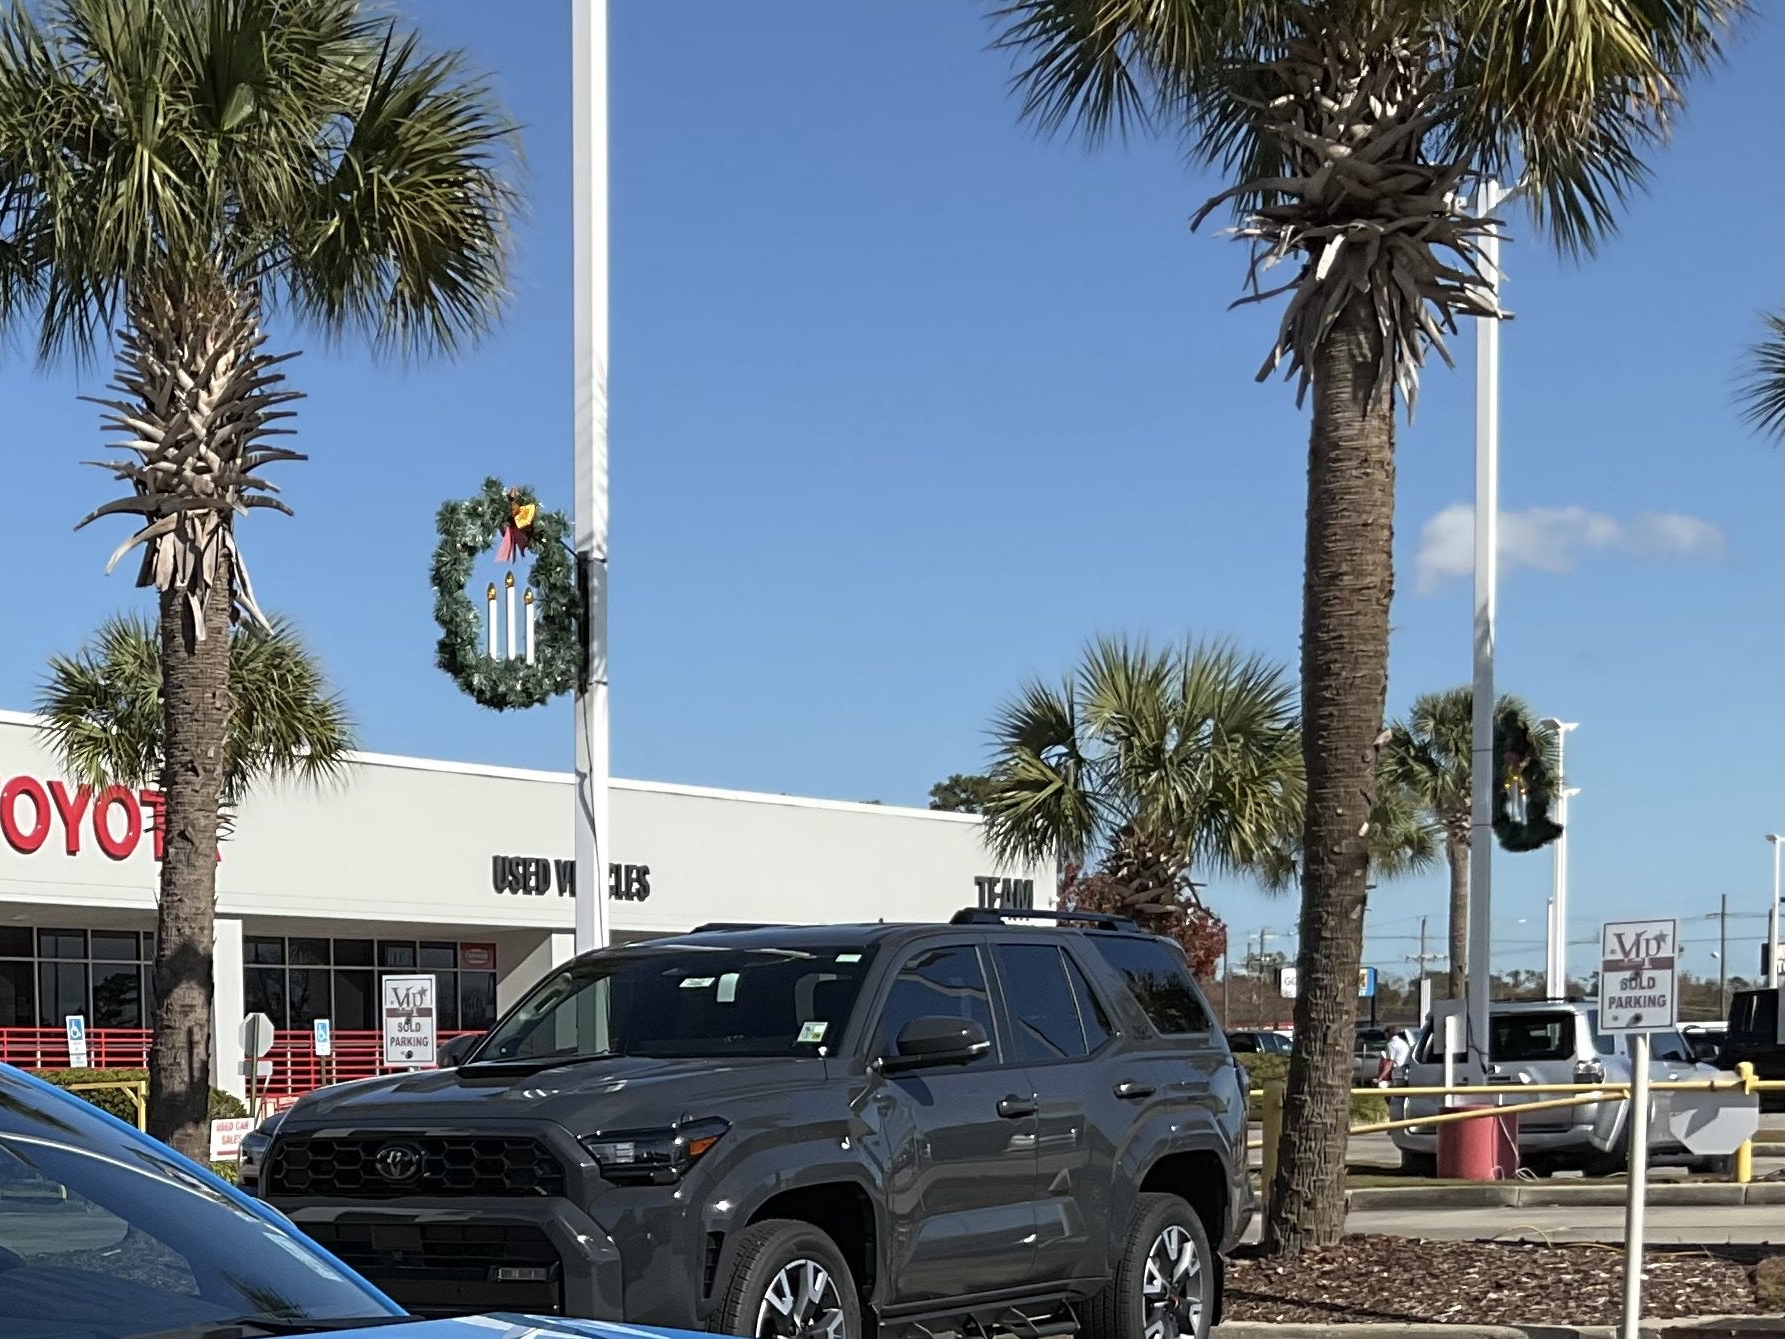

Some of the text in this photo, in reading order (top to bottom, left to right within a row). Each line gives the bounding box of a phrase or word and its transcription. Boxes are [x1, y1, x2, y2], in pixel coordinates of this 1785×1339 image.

[492, 855, 551, 895] USED
[974, 876, 1033, 920] TEAM
[1620, 976, 1656, 991] SOLD
[1608, 994, 1667, 1009] PARKING
[398, 1022, 421, 1033] SOLD
[390, 1036, 429, 1047] PARKING
